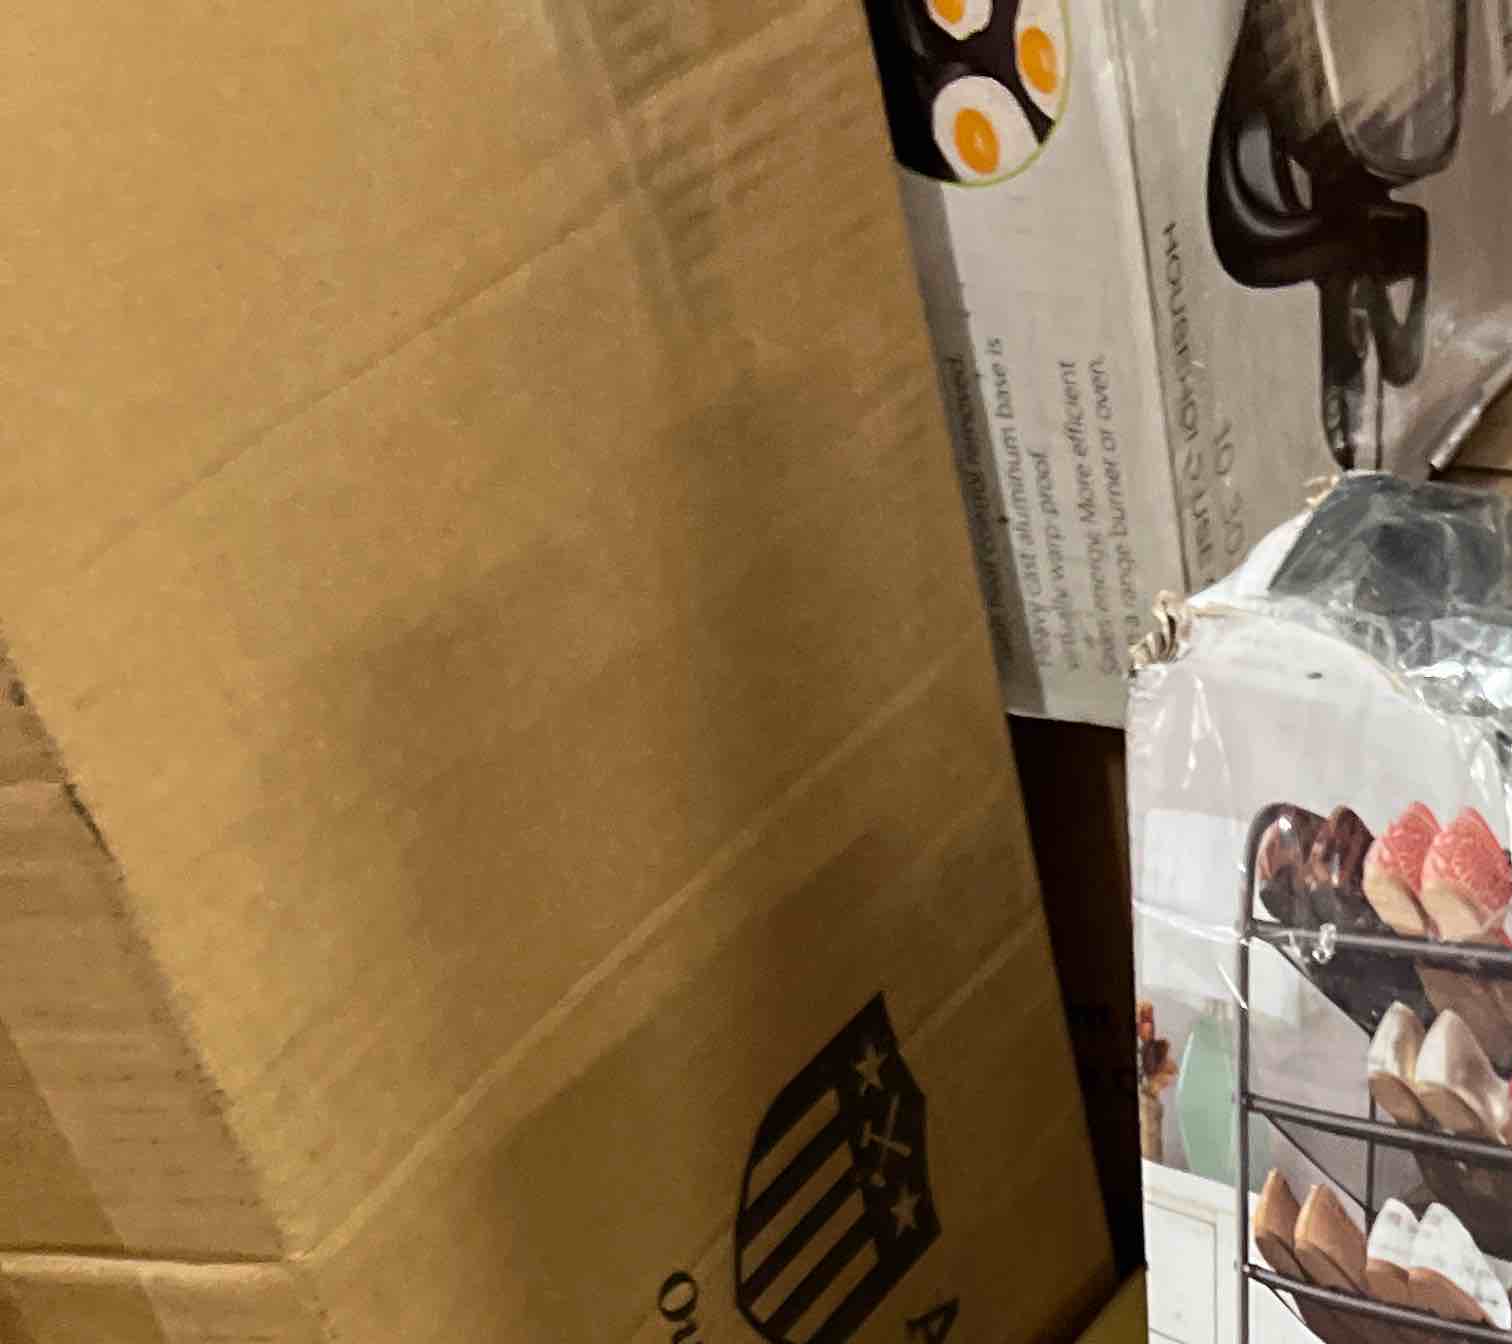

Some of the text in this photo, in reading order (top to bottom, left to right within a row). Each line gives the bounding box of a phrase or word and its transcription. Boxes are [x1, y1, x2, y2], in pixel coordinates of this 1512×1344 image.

[993, 363, 1015, 420] base
[1058, 360, 1087, 456] efficient
[1000, 426, 1034, 546] aluminum
[1074, 463, 1096, 526] More
